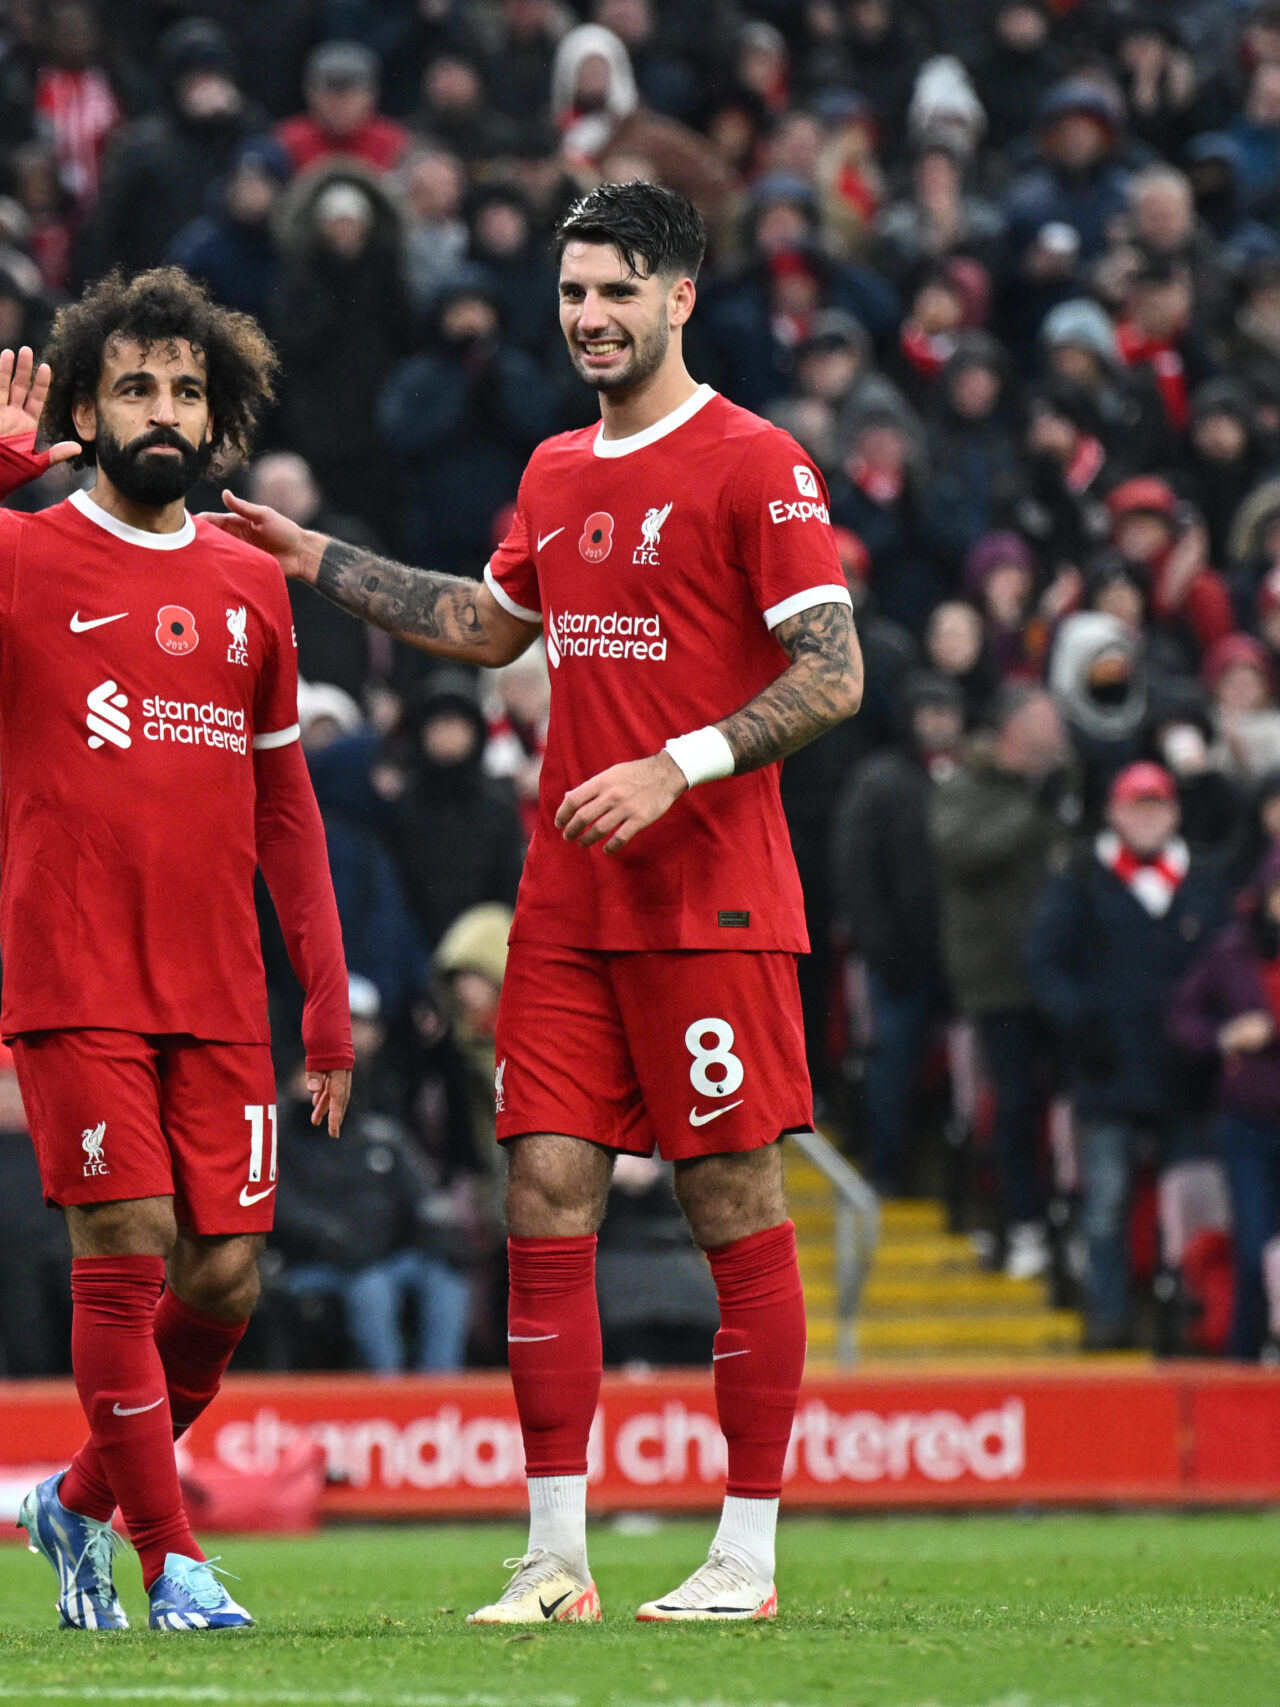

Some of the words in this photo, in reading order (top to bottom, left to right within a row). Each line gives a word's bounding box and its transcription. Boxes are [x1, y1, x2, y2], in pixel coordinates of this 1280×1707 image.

[557, 610, 660, 637] standard
[165, 639, 189, 651] 2023
[142, 694, 245, 731] standard
[143, 718, 247, 756] chartered
[684, 1017, 745, 1098] 8
[244, 1103, 278, 1182] 11
